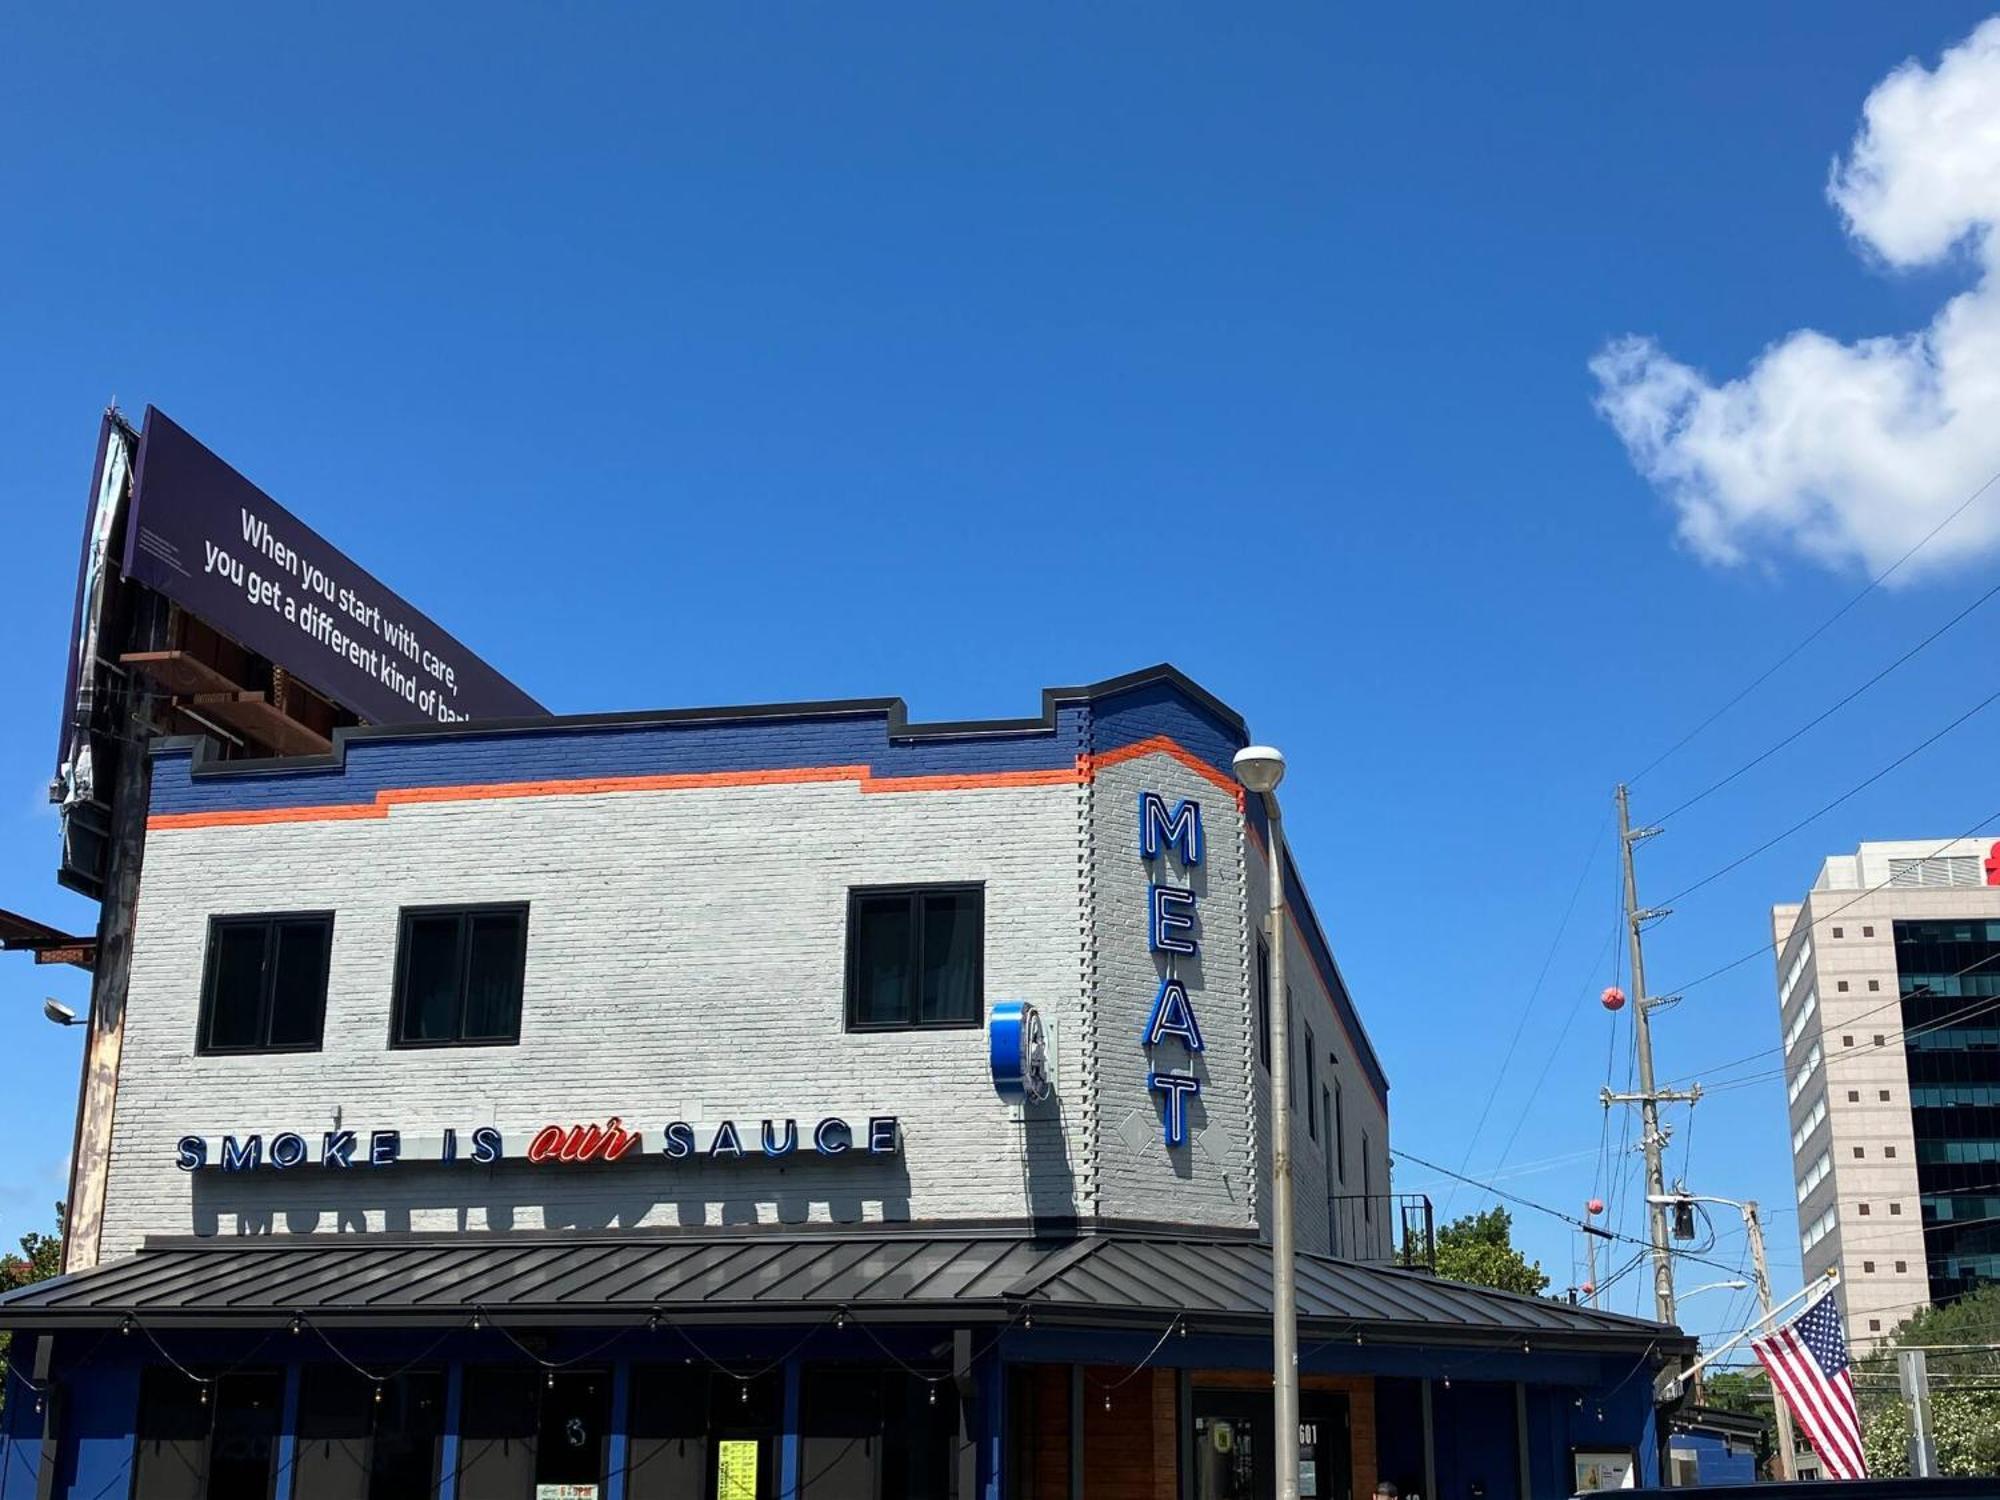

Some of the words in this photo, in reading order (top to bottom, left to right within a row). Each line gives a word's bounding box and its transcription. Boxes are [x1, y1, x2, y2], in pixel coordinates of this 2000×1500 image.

[204, 539, 243, 587] you
[247, 571, 281, 612] get
[284, 597, 296, 623] a
[300, 602, 377, 678] different
[381, 653, 416, 703] kind
[419, 690, 436, 715] of
[242, 507, 297, 576] When
[302, 560, 335, 603] you
[338, 588, 380, 635] start
[384, 619, 419, 663] with
[423, 650, 458, 696] care,
[1139, 791, 1205, 1148] MEAT
[176, 1129, 400, 1173] SMOKE
[442, 1126, 503, 1167] IS
[528, 1116, 642, 1163] our
[663, 1116, 898, 1159] SAUCE
[1299, 1424, 1317, 1444] 601
